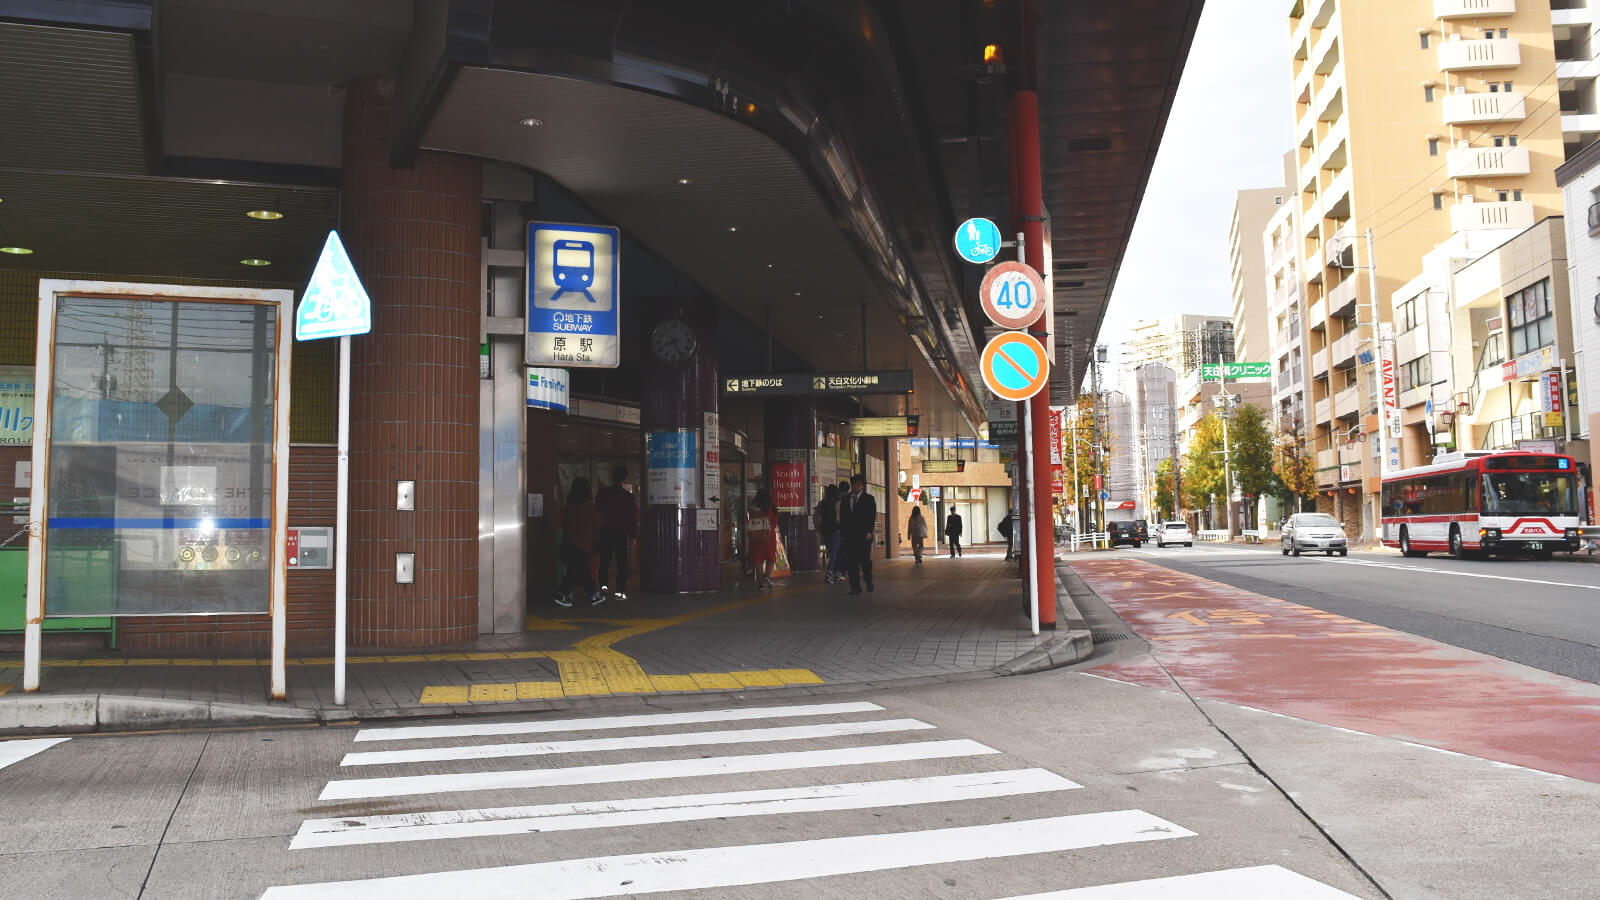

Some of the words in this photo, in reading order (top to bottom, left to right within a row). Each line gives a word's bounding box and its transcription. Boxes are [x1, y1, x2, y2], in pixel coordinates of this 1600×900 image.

[997, 280, 1032, 309] 40
[565, 313, 593, 324] 地下鉄
[553, 322, 593, 332] SUBWAY
[553, 352, 574, 361] Hara
[576, 352, 593, 362] Sta.
[741, 378, 783, 388] 地下鉄のりば
